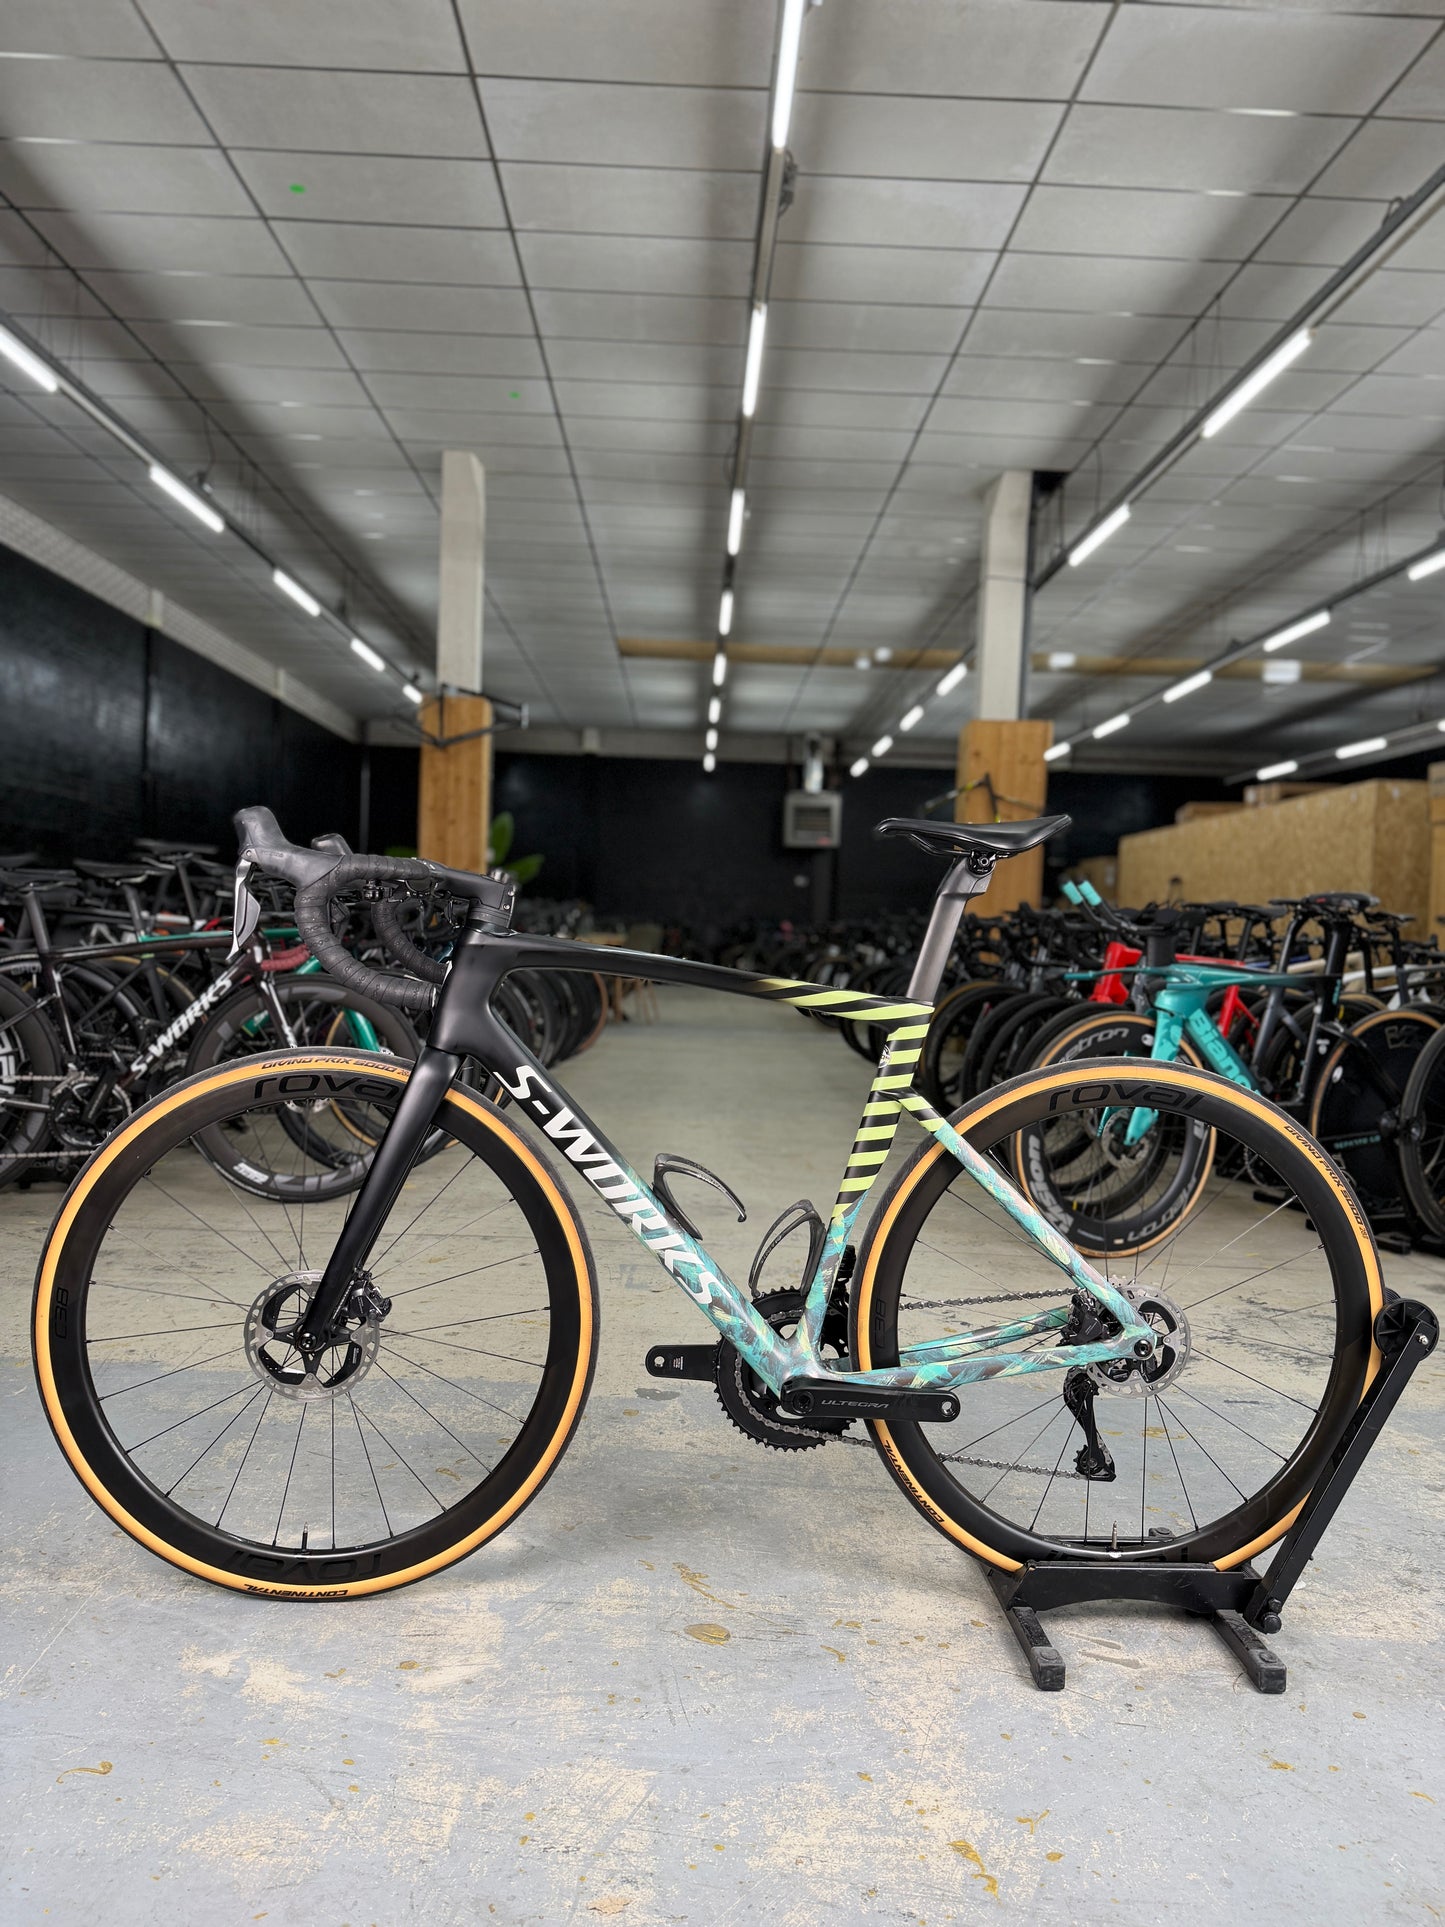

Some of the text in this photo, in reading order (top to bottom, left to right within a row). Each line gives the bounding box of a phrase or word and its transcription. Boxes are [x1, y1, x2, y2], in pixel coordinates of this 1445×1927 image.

[131, 967, 239, 1080] S-WORKS
[315, 1056, 352, 1065] PRIX
[353, 1059, 398, 1073] 5000
[1187, 1010, 1260, 1094] Bianc
[254, 1074, 400, 1099] rova
[1049, 1083, 1205, 1112] roval
[492, 1065, 733, 1304] S-WORKS
[1319, 1160, 1343, 1187] PRIX
[821, 1399, 889, 1409] ULTEGRA
[884, 1439, 945, 1523] CONTINENTAL
[244, 1583, 348, 1598] CONTINENTAL
